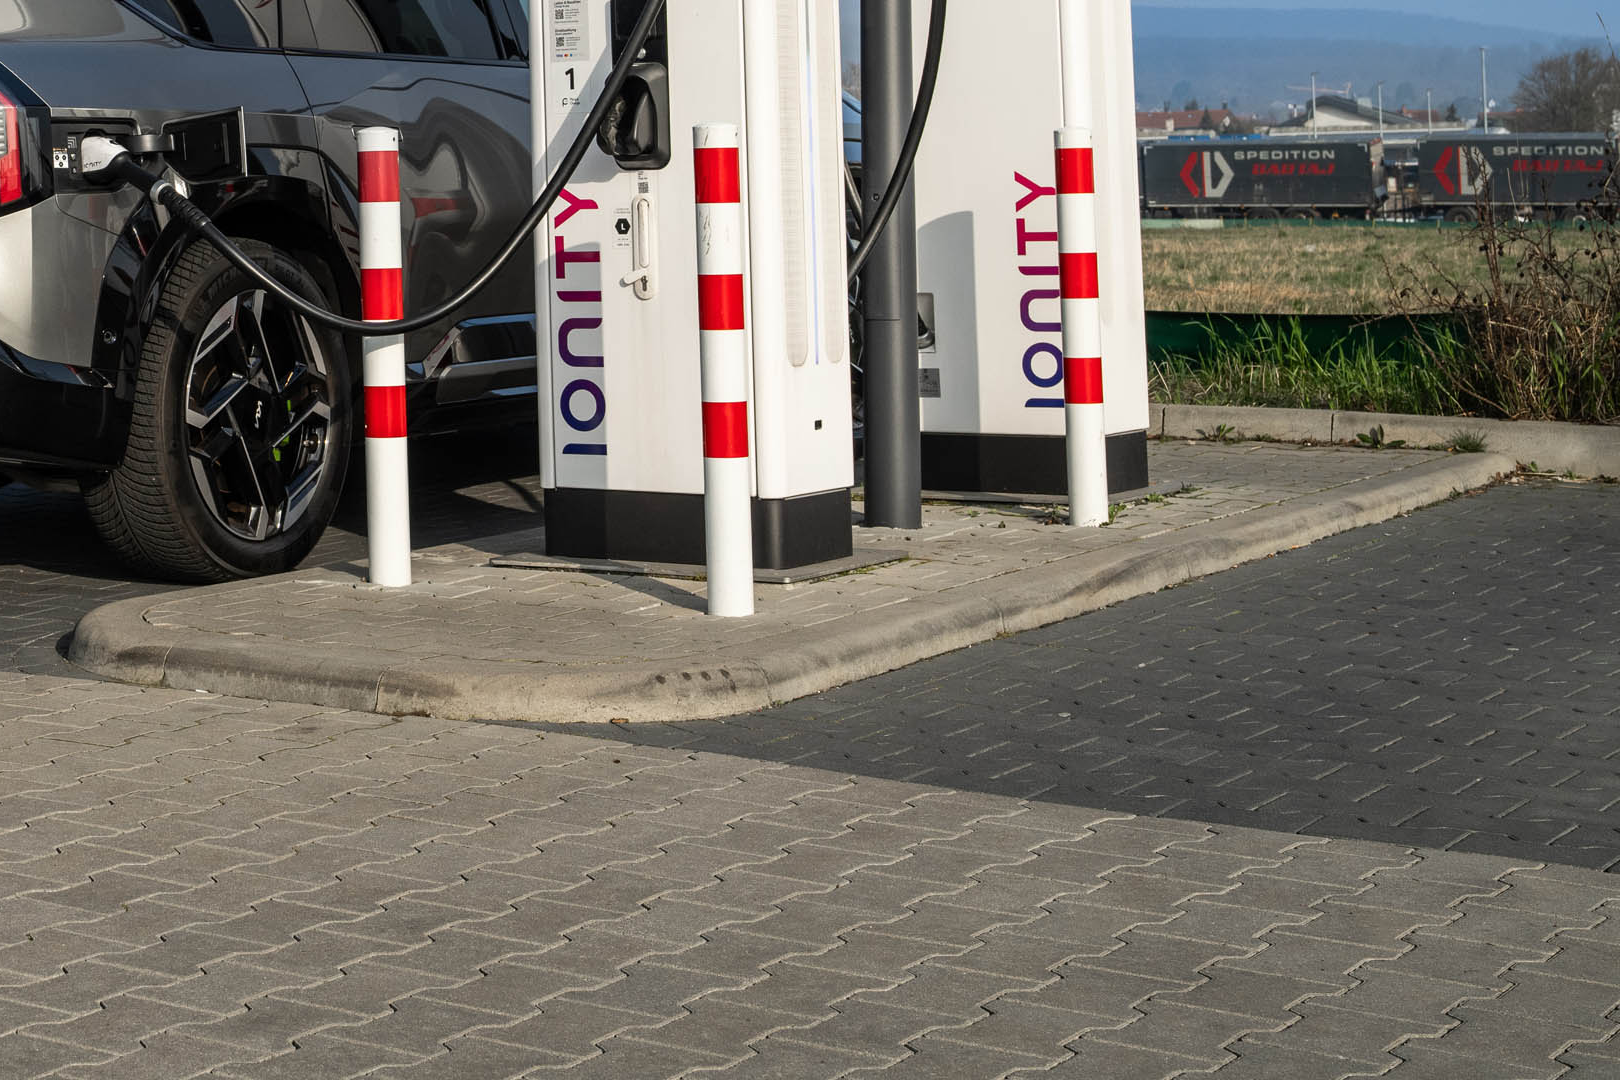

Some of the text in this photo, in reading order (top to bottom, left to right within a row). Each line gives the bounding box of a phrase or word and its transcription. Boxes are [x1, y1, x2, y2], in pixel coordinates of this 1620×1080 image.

[565, 67, 575, 90] 1
[1234, 150, 1335, 160] SPEDITION
[1492, 146, 1605, 156] SPEDITION
[1014, 171, 1065, 408] IONITY
[554, 186, 608, 456] IONITY
